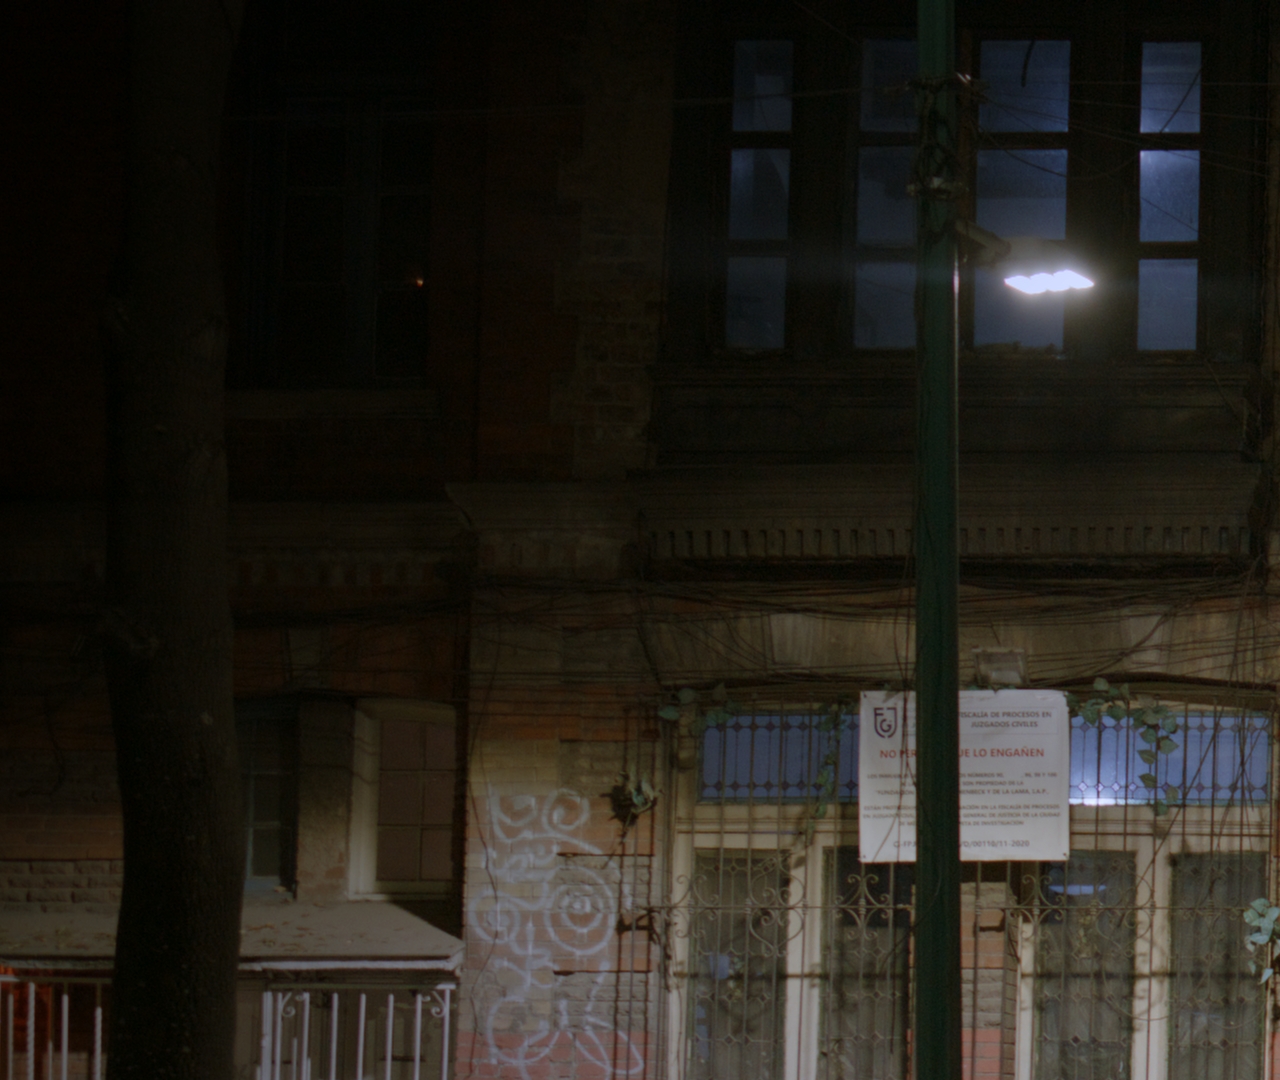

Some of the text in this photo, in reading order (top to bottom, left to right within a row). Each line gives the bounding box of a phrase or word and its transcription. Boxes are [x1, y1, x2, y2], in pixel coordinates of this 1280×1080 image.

[880, 750, 897, 759] NO
[973, 748, 988, 758] LO
[990, 746, 1045, 758] ENGAÑEN
